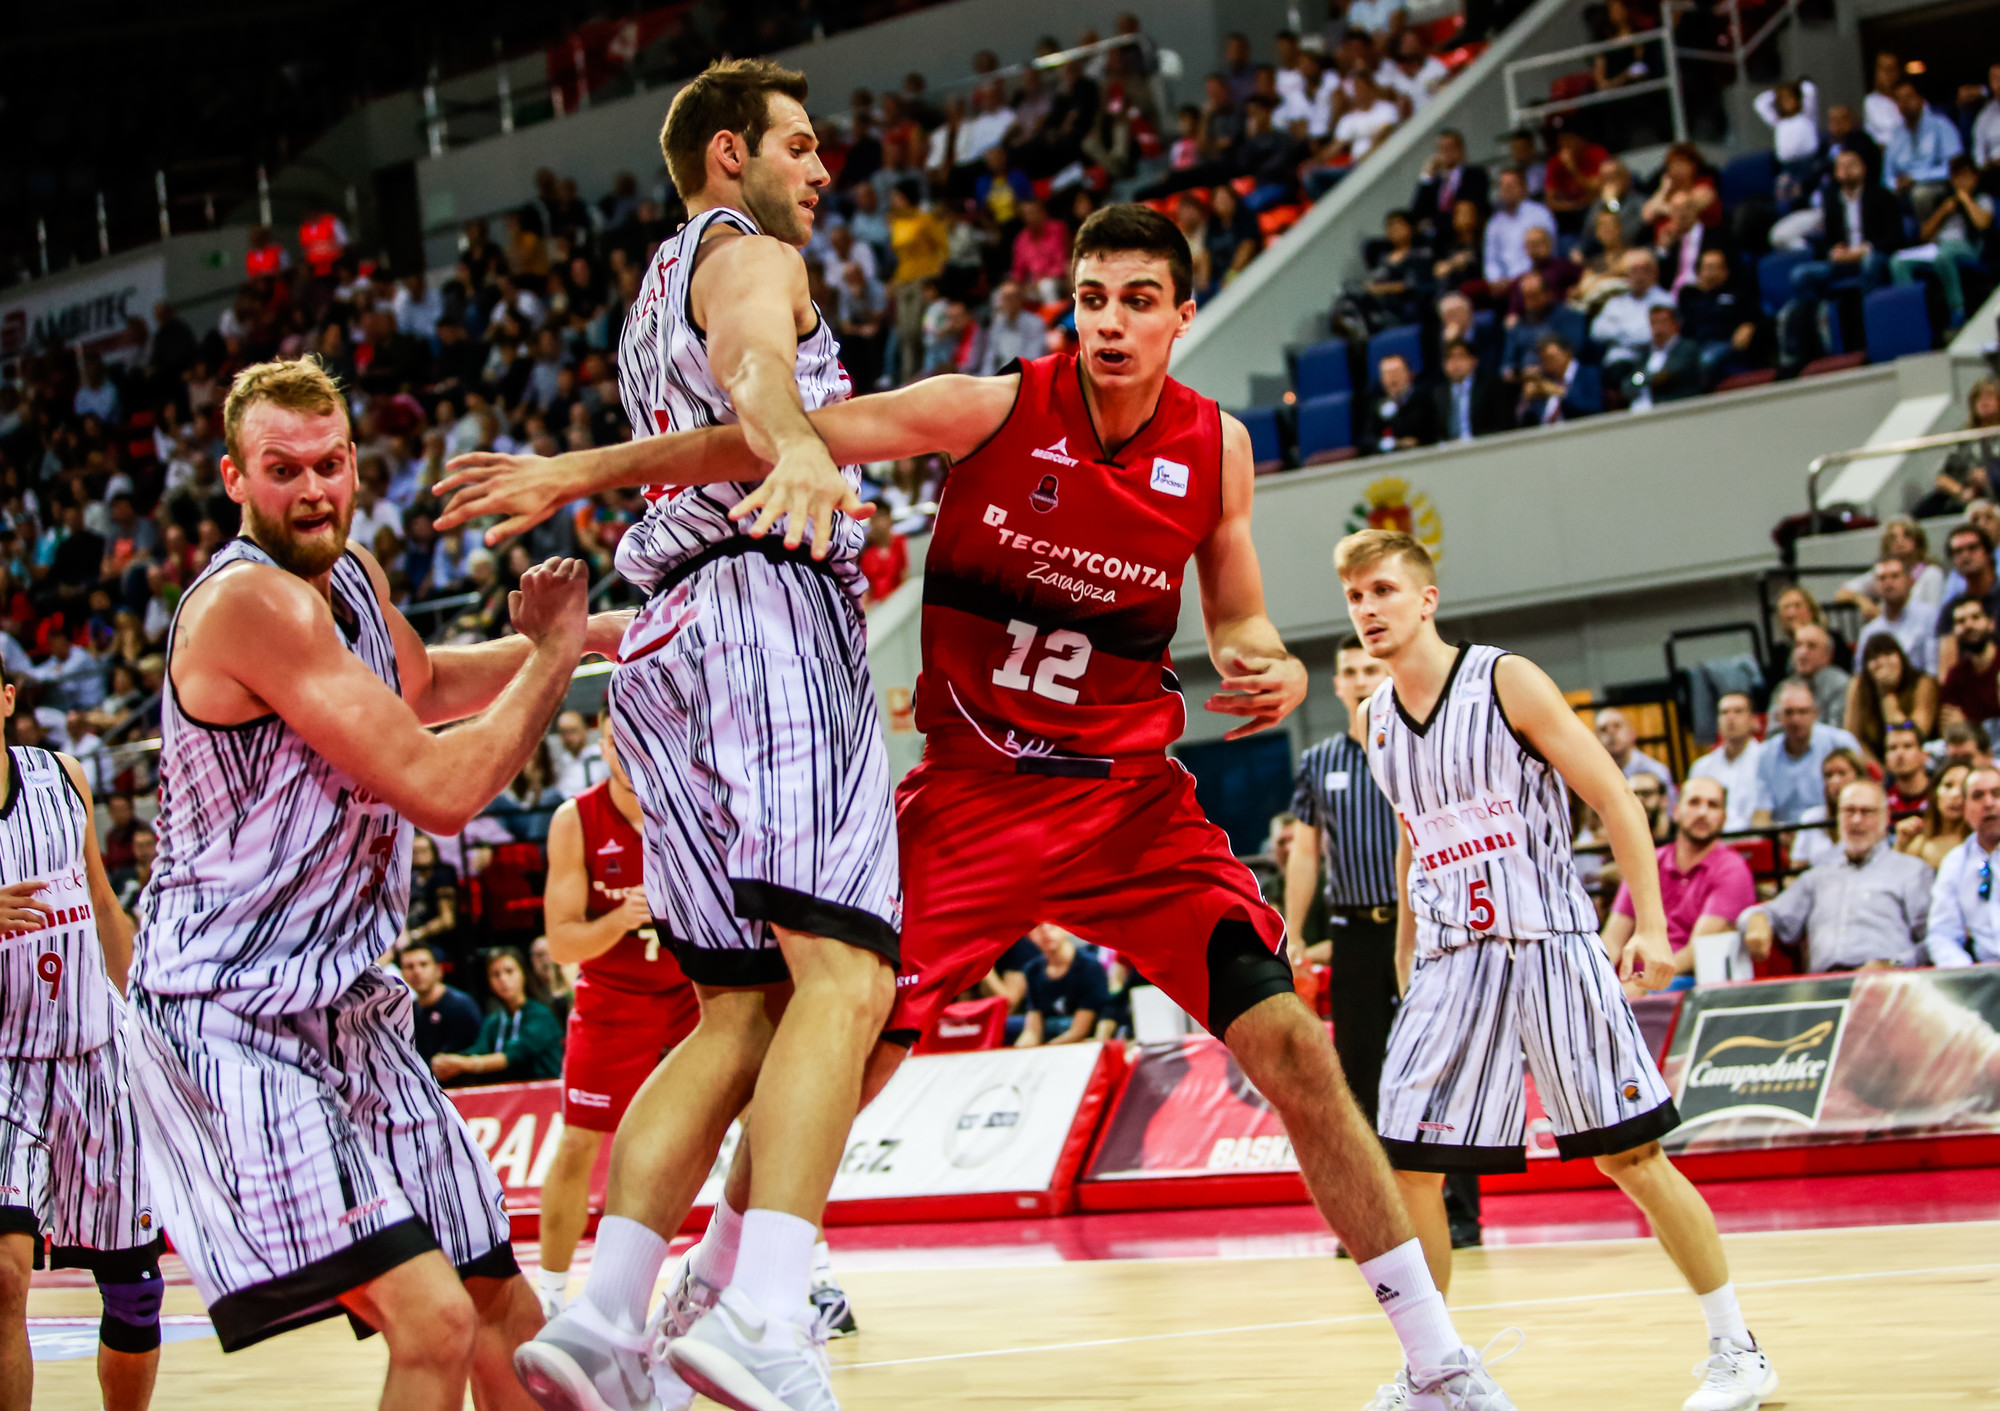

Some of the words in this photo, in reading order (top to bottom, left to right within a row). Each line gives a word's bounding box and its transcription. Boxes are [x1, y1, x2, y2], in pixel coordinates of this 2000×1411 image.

[1031, 448, 1079, 467] MERCURY
[1026, 561, 1116, 603] Zaragoza
[992, 618, 1093, 705] 12
[1468, 879, 1496, 931] 5
[37, 952, 63, 1001] 9
[1688, 1052, 1828, 1092] Campodulce
